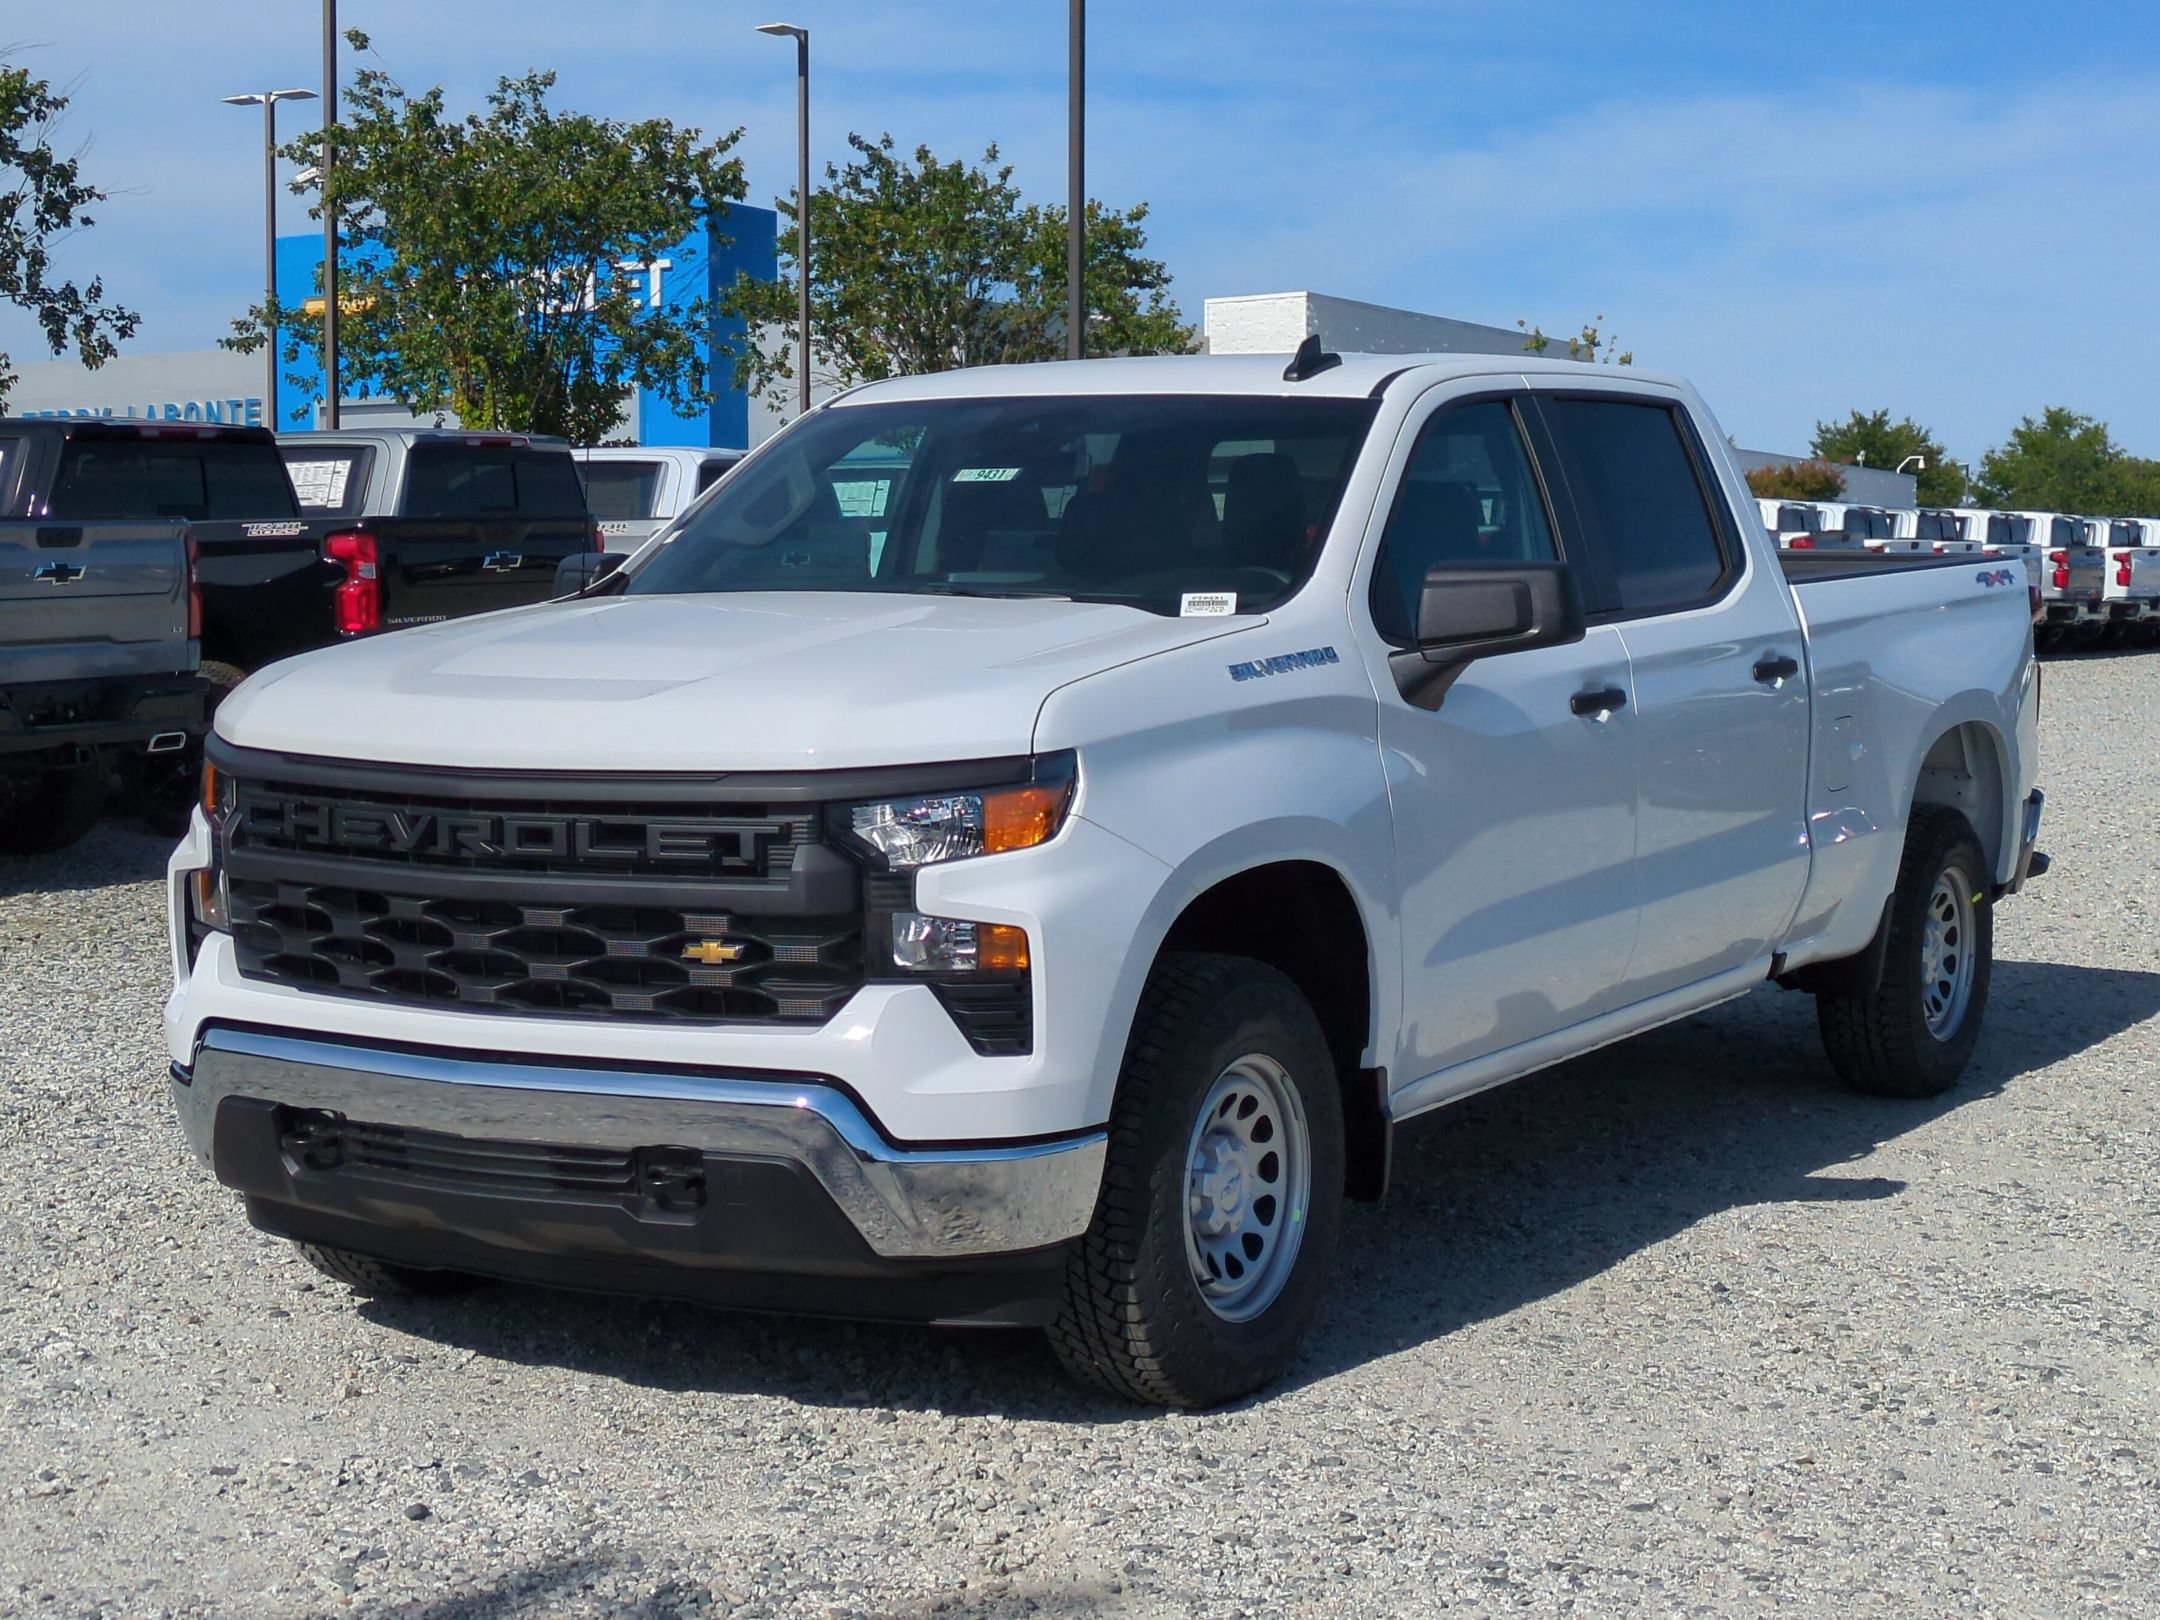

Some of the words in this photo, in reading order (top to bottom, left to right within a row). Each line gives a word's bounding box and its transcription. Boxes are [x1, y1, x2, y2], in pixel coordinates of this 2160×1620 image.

[387, 615, 447, 624] SILVERADO
[1227, 646, 1340, 682] SILVERADO
[242, 802, 788, 865] CHEVROLET
